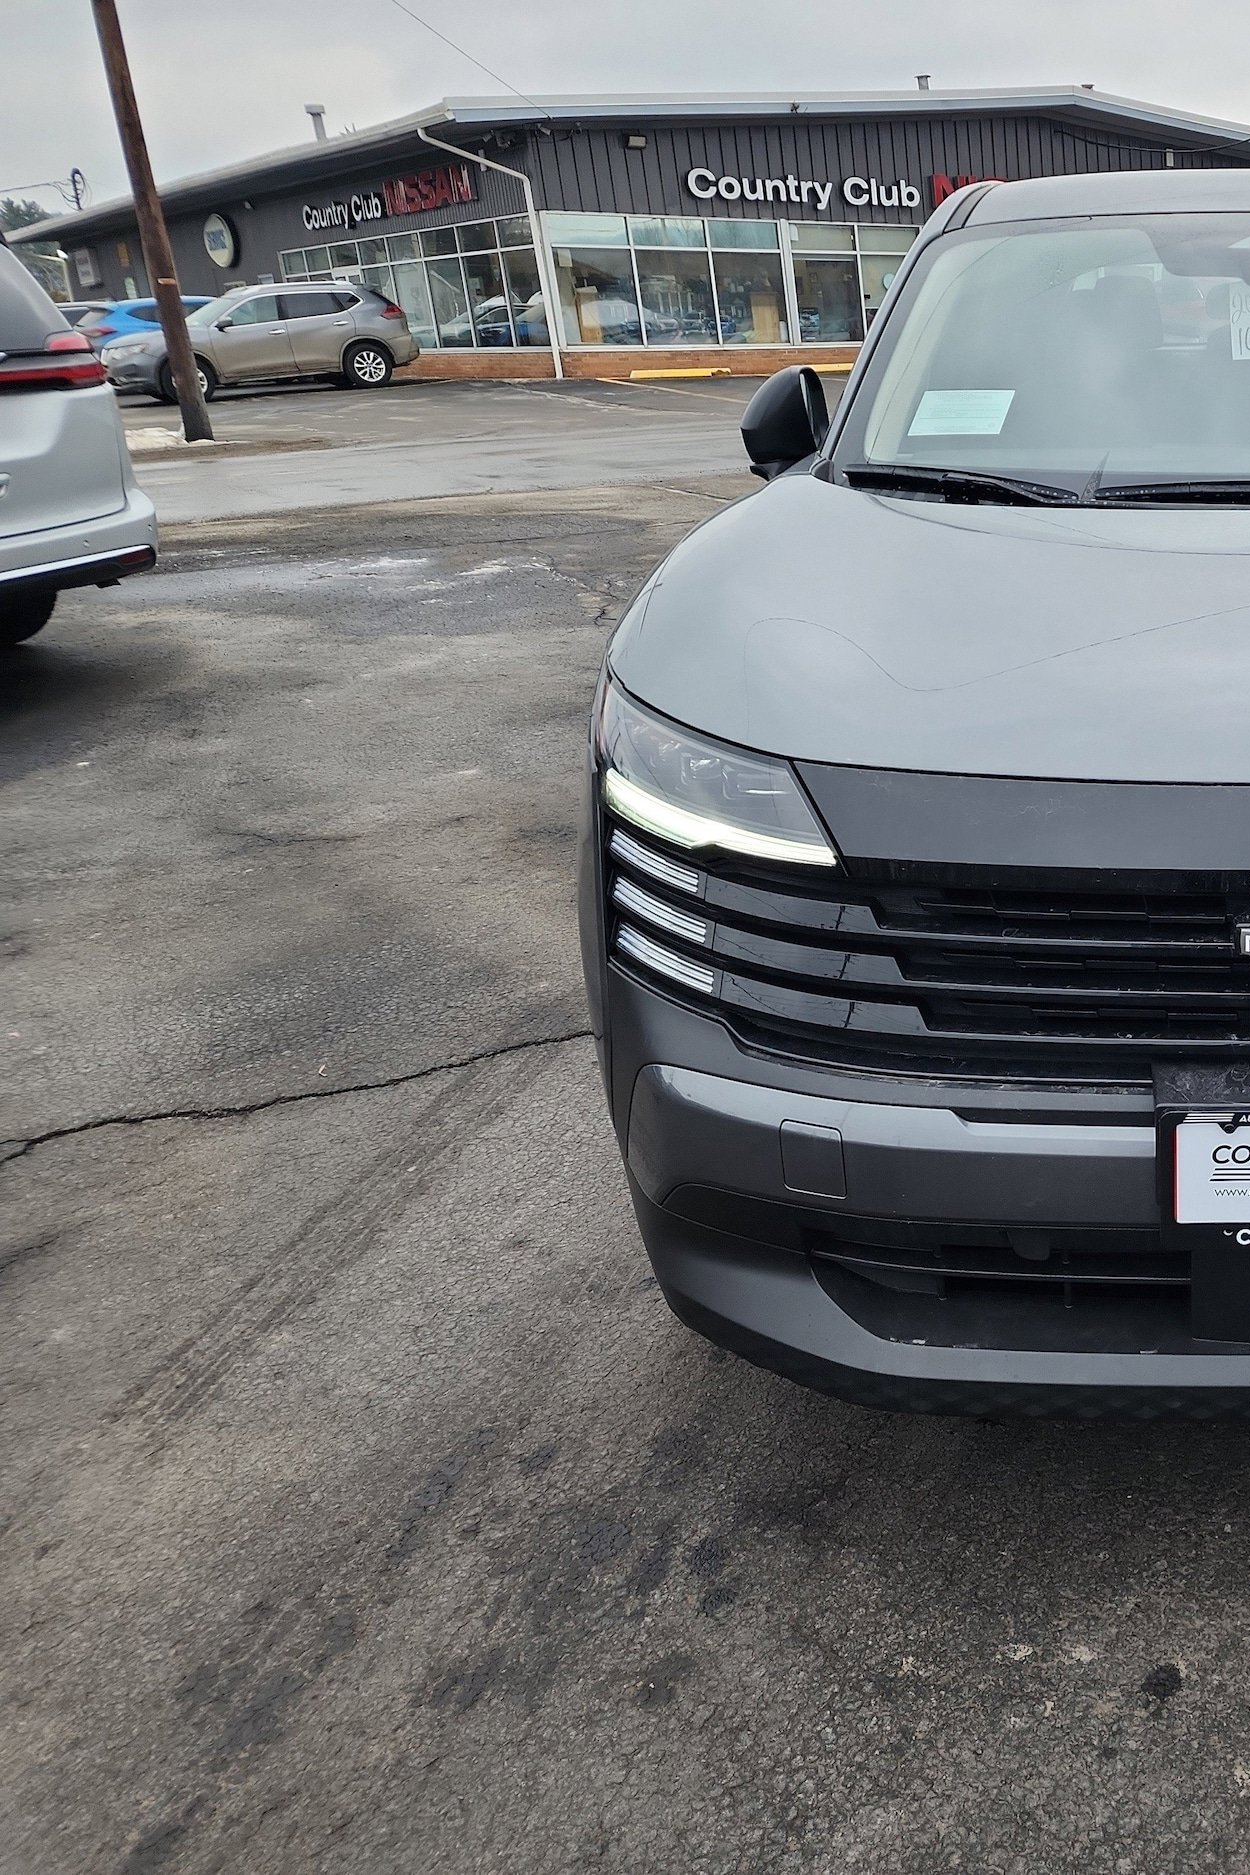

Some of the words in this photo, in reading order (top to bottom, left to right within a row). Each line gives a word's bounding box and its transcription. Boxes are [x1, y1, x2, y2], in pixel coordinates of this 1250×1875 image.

[303, 204, 349, 230] Country
[351, 192, 382, 221] Club
[382, 163, 472, 217] NISSAN
[687, 167, 832, 211] Country
[843, 176, 921, 208] Club
